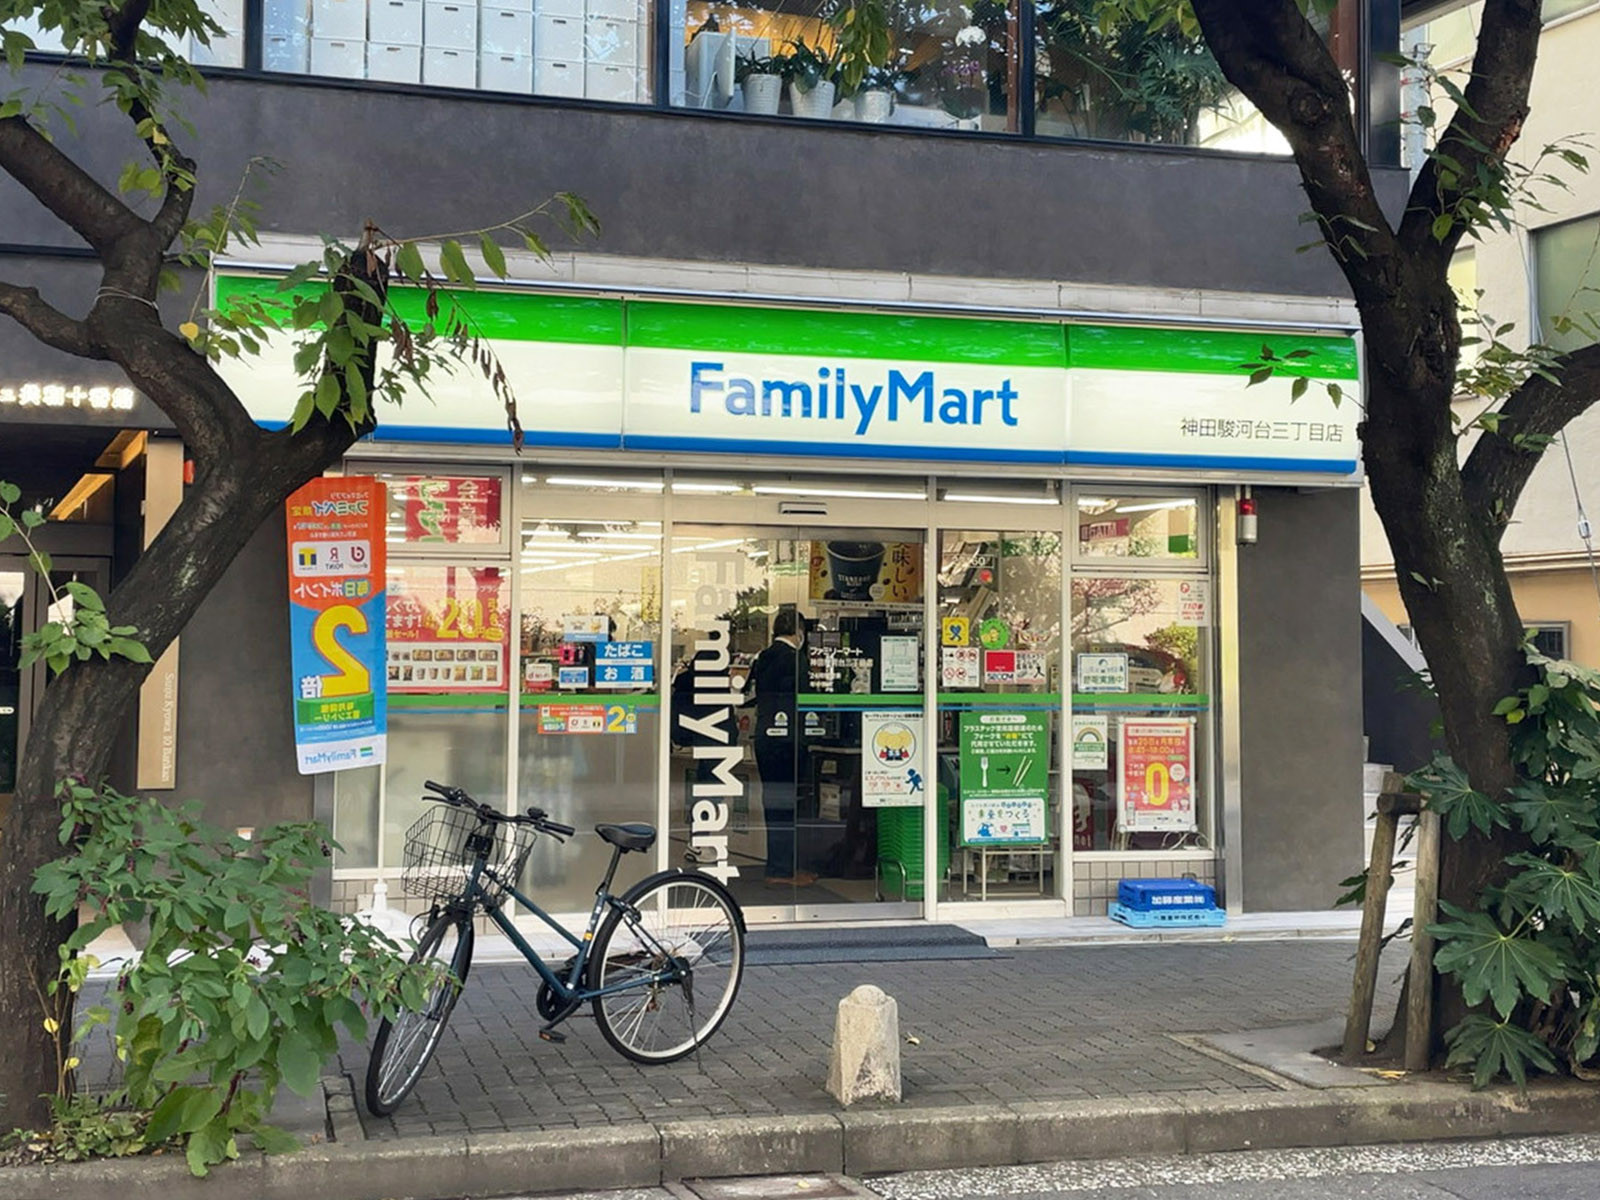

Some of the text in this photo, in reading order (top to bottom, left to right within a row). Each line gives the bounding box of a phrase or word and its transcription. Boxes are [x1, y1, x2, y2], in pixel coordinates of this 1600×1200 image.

[690, 361, 1018, 435] FamilyMart
[1180, 418, 1343, 442] 神田駿河台三丁目店
[891, 543, 913, 597] 味しい
[604, 643, 644, 658] たばこ
[810, 647, 863, 656] ファミリーマート
[678, 552, 744, 886] FamilyMart
[1145, 762, 1169, 806] 0
